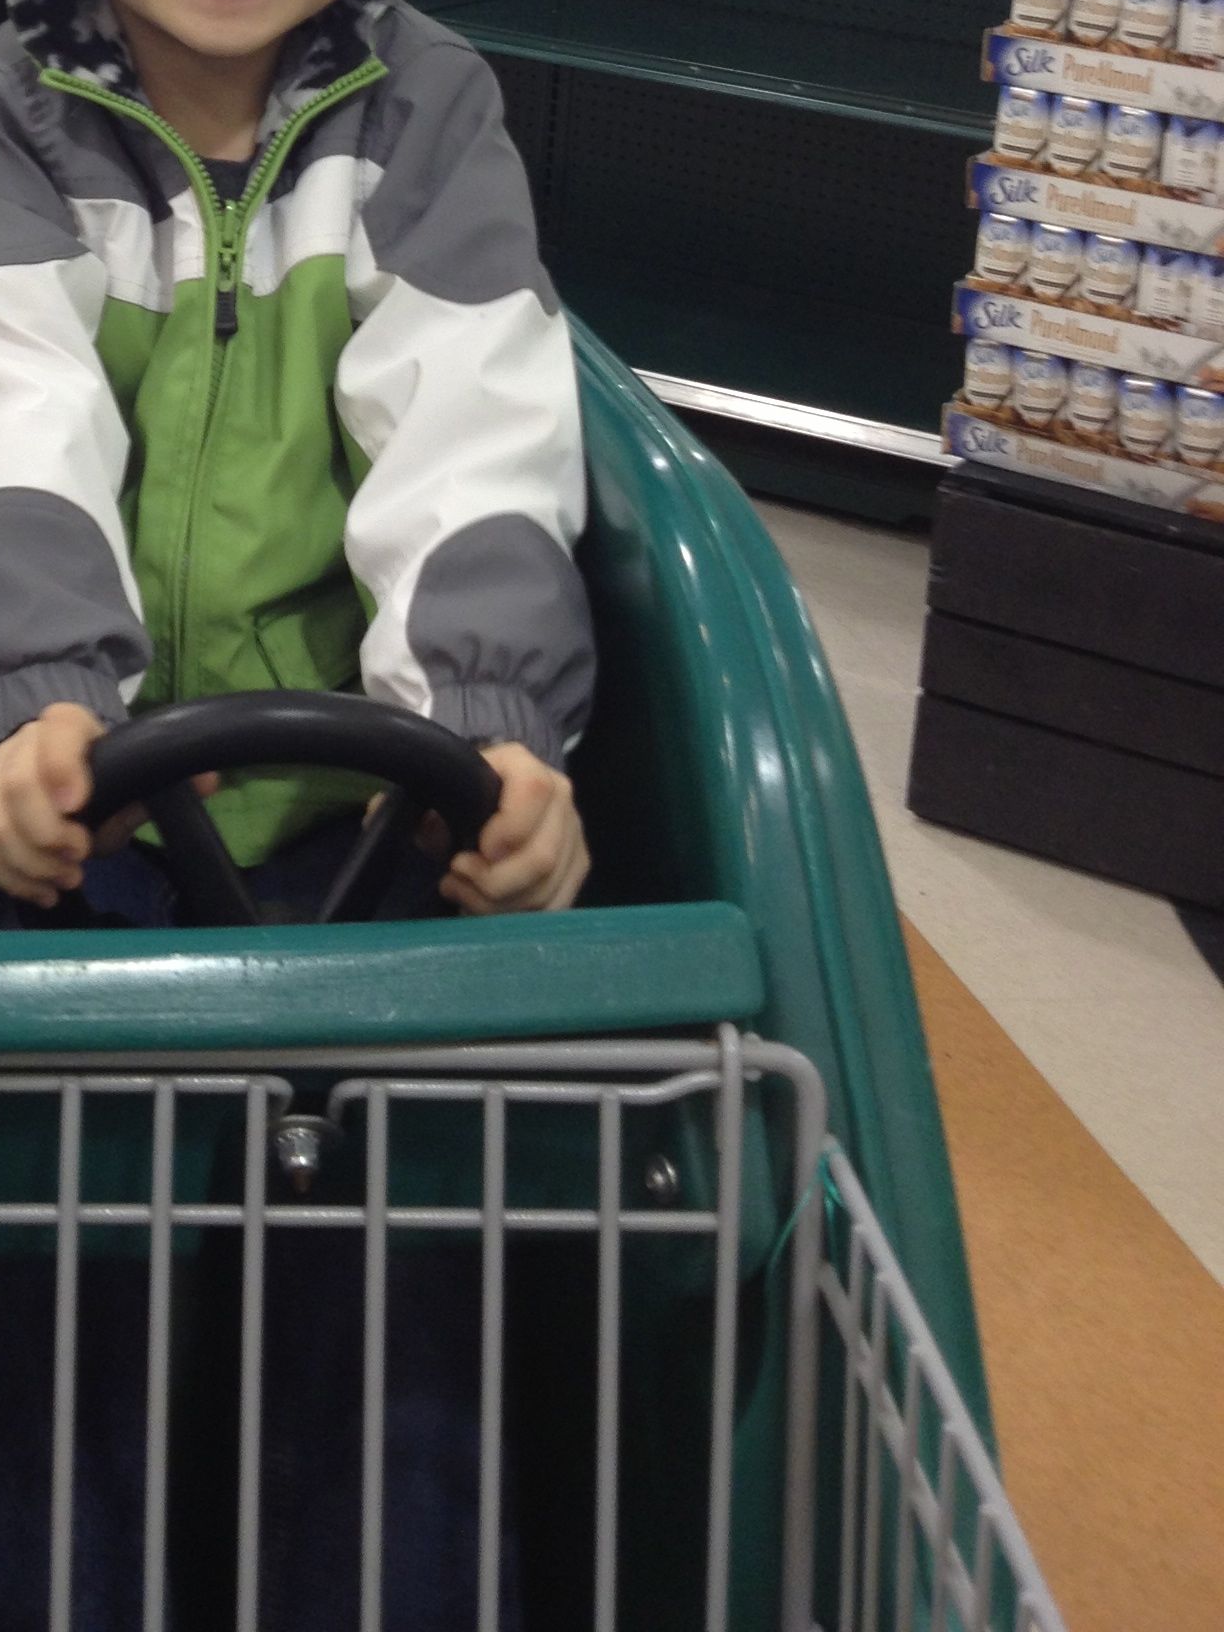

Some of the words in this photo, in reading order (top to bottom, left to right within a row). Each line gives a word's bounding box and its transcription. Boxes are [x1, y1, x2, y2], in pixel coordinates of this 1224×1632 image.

[1006, 47, 1056, 76] Silk
[990, 176, 1040, 204] Silk
[974, 301, 1024, 329] Silk
[963, 426, 1010, 456] Silk
